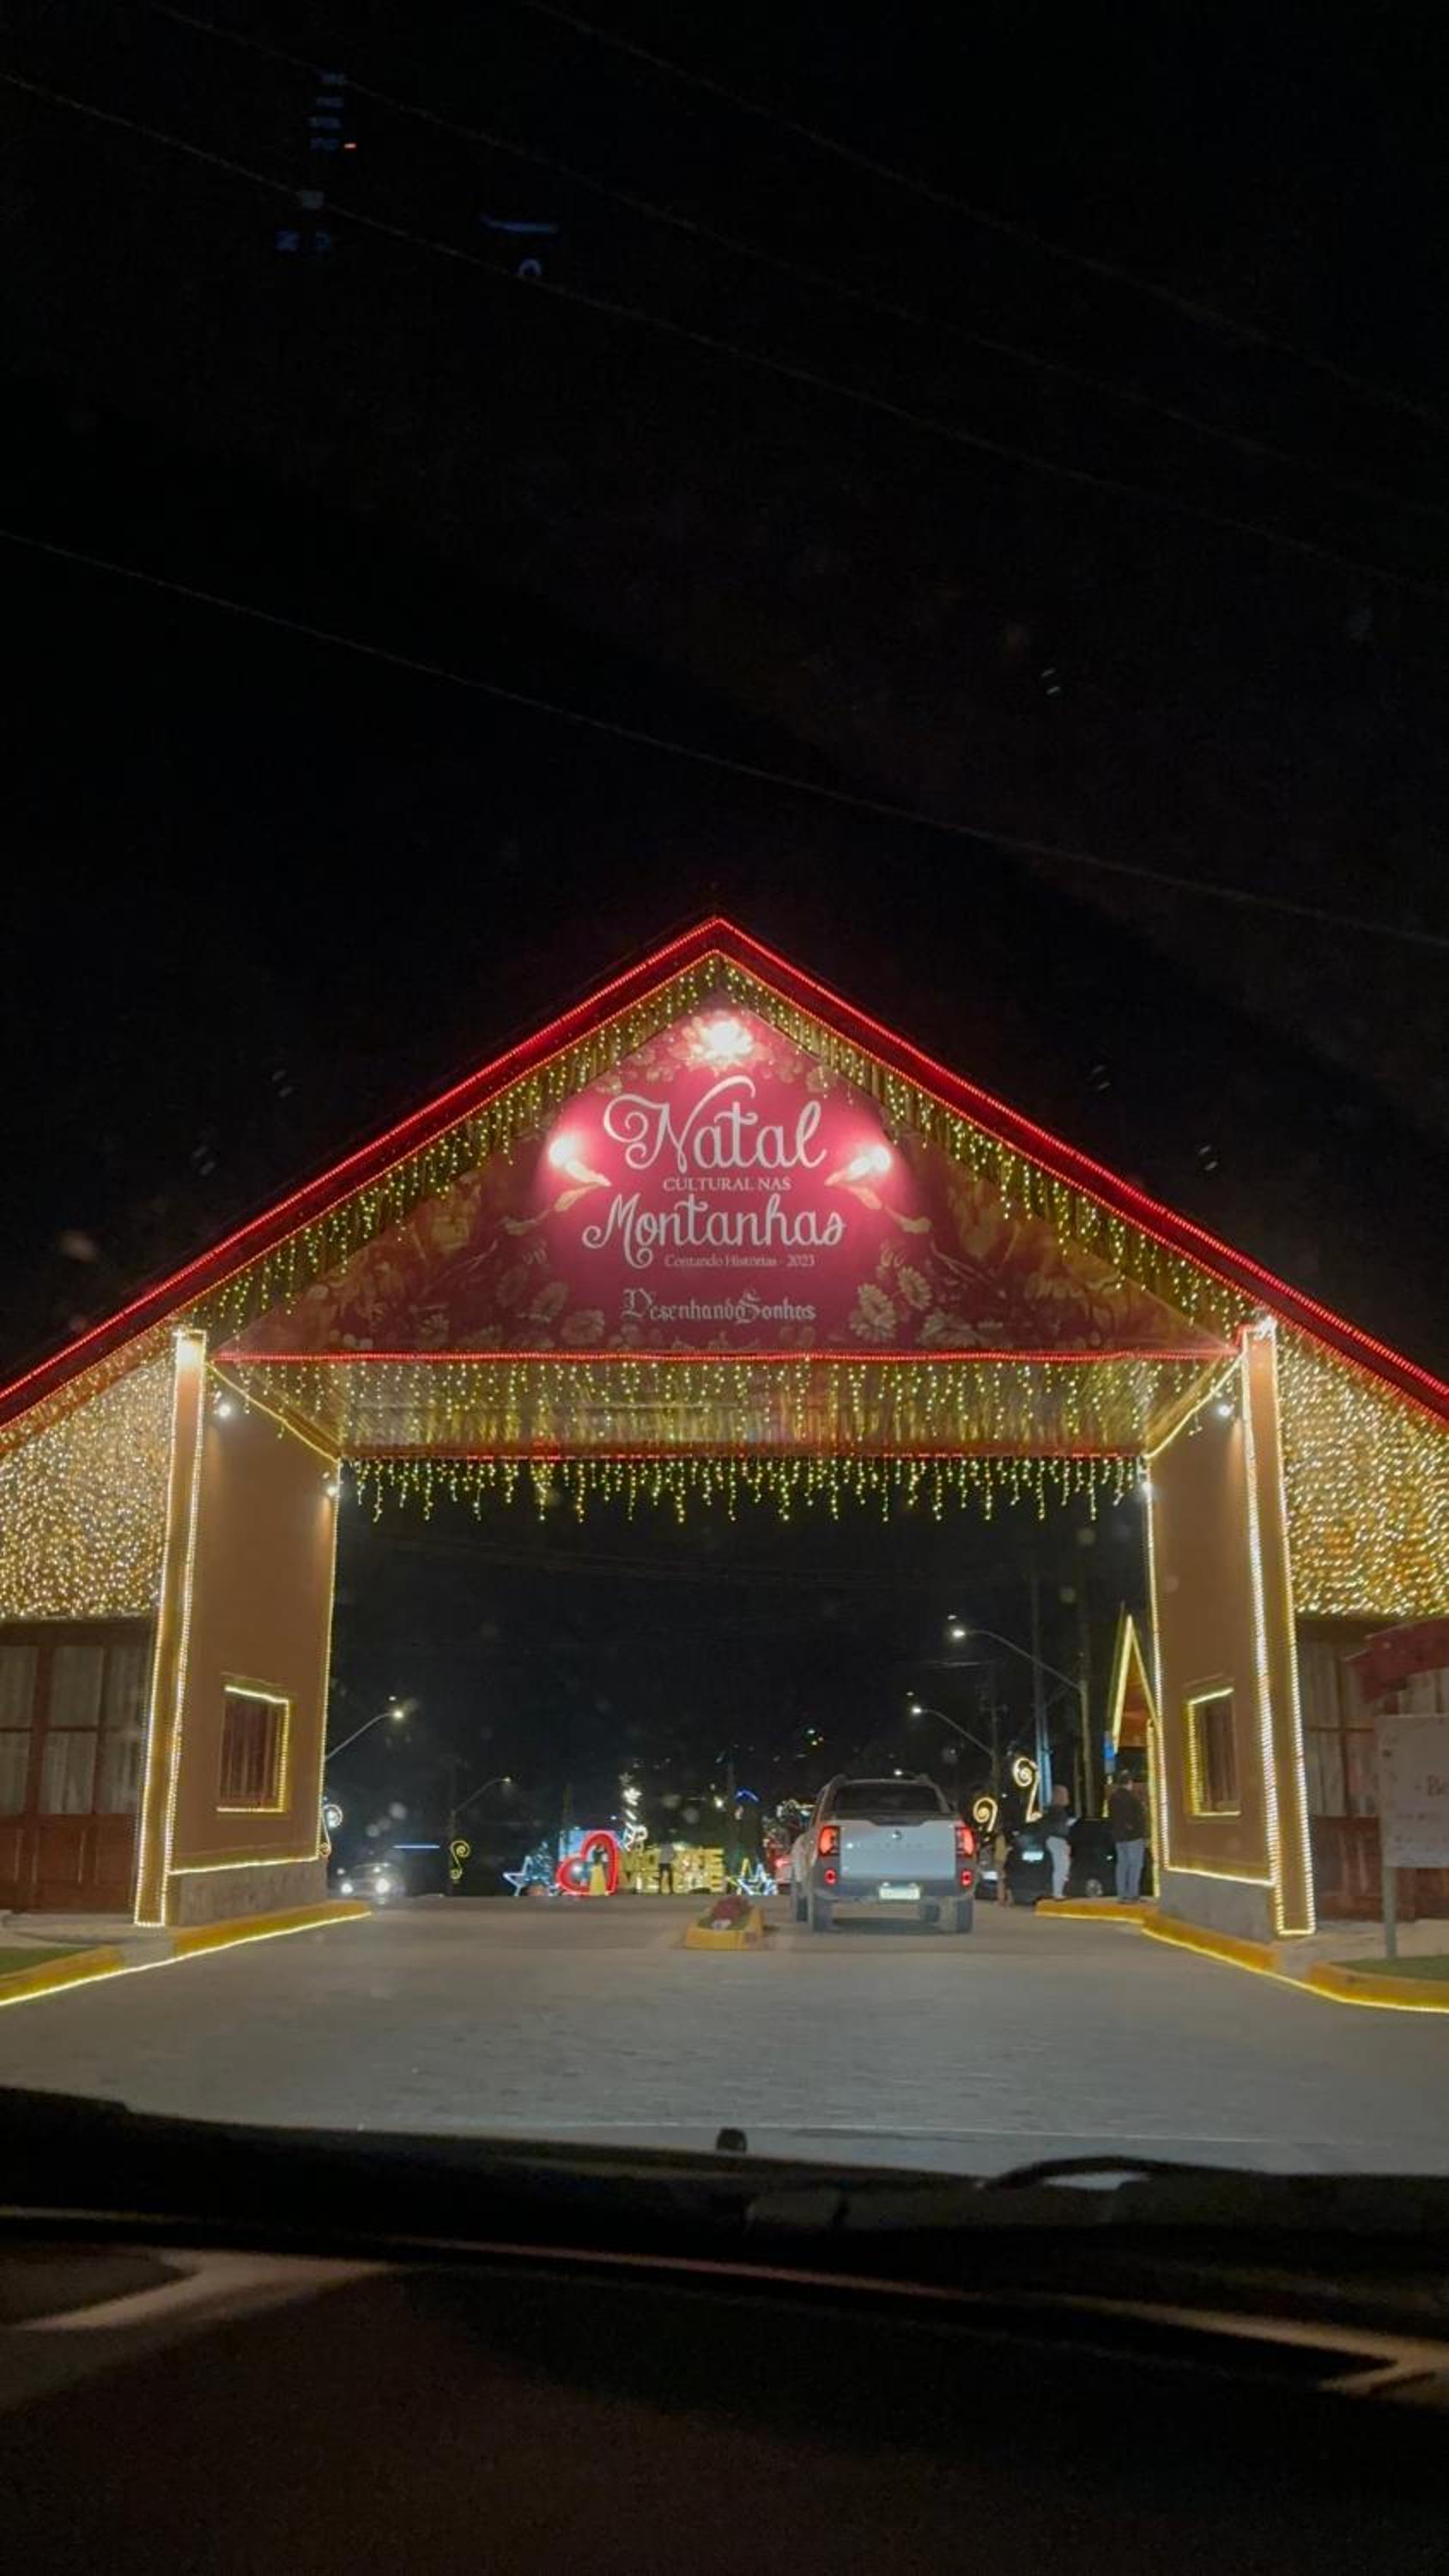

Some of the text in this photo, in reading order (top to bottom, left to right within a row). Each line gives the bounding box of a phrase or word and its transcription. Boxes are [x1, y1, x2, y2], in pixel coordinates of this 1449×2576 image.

[603, 1076, 827, 1173] Natal
[663, 1176, 791, 1192] CULTURAL NAS
[582, 1193, 846, 1269] Montanhas
[787, 1254, 815, 1267] 2023
